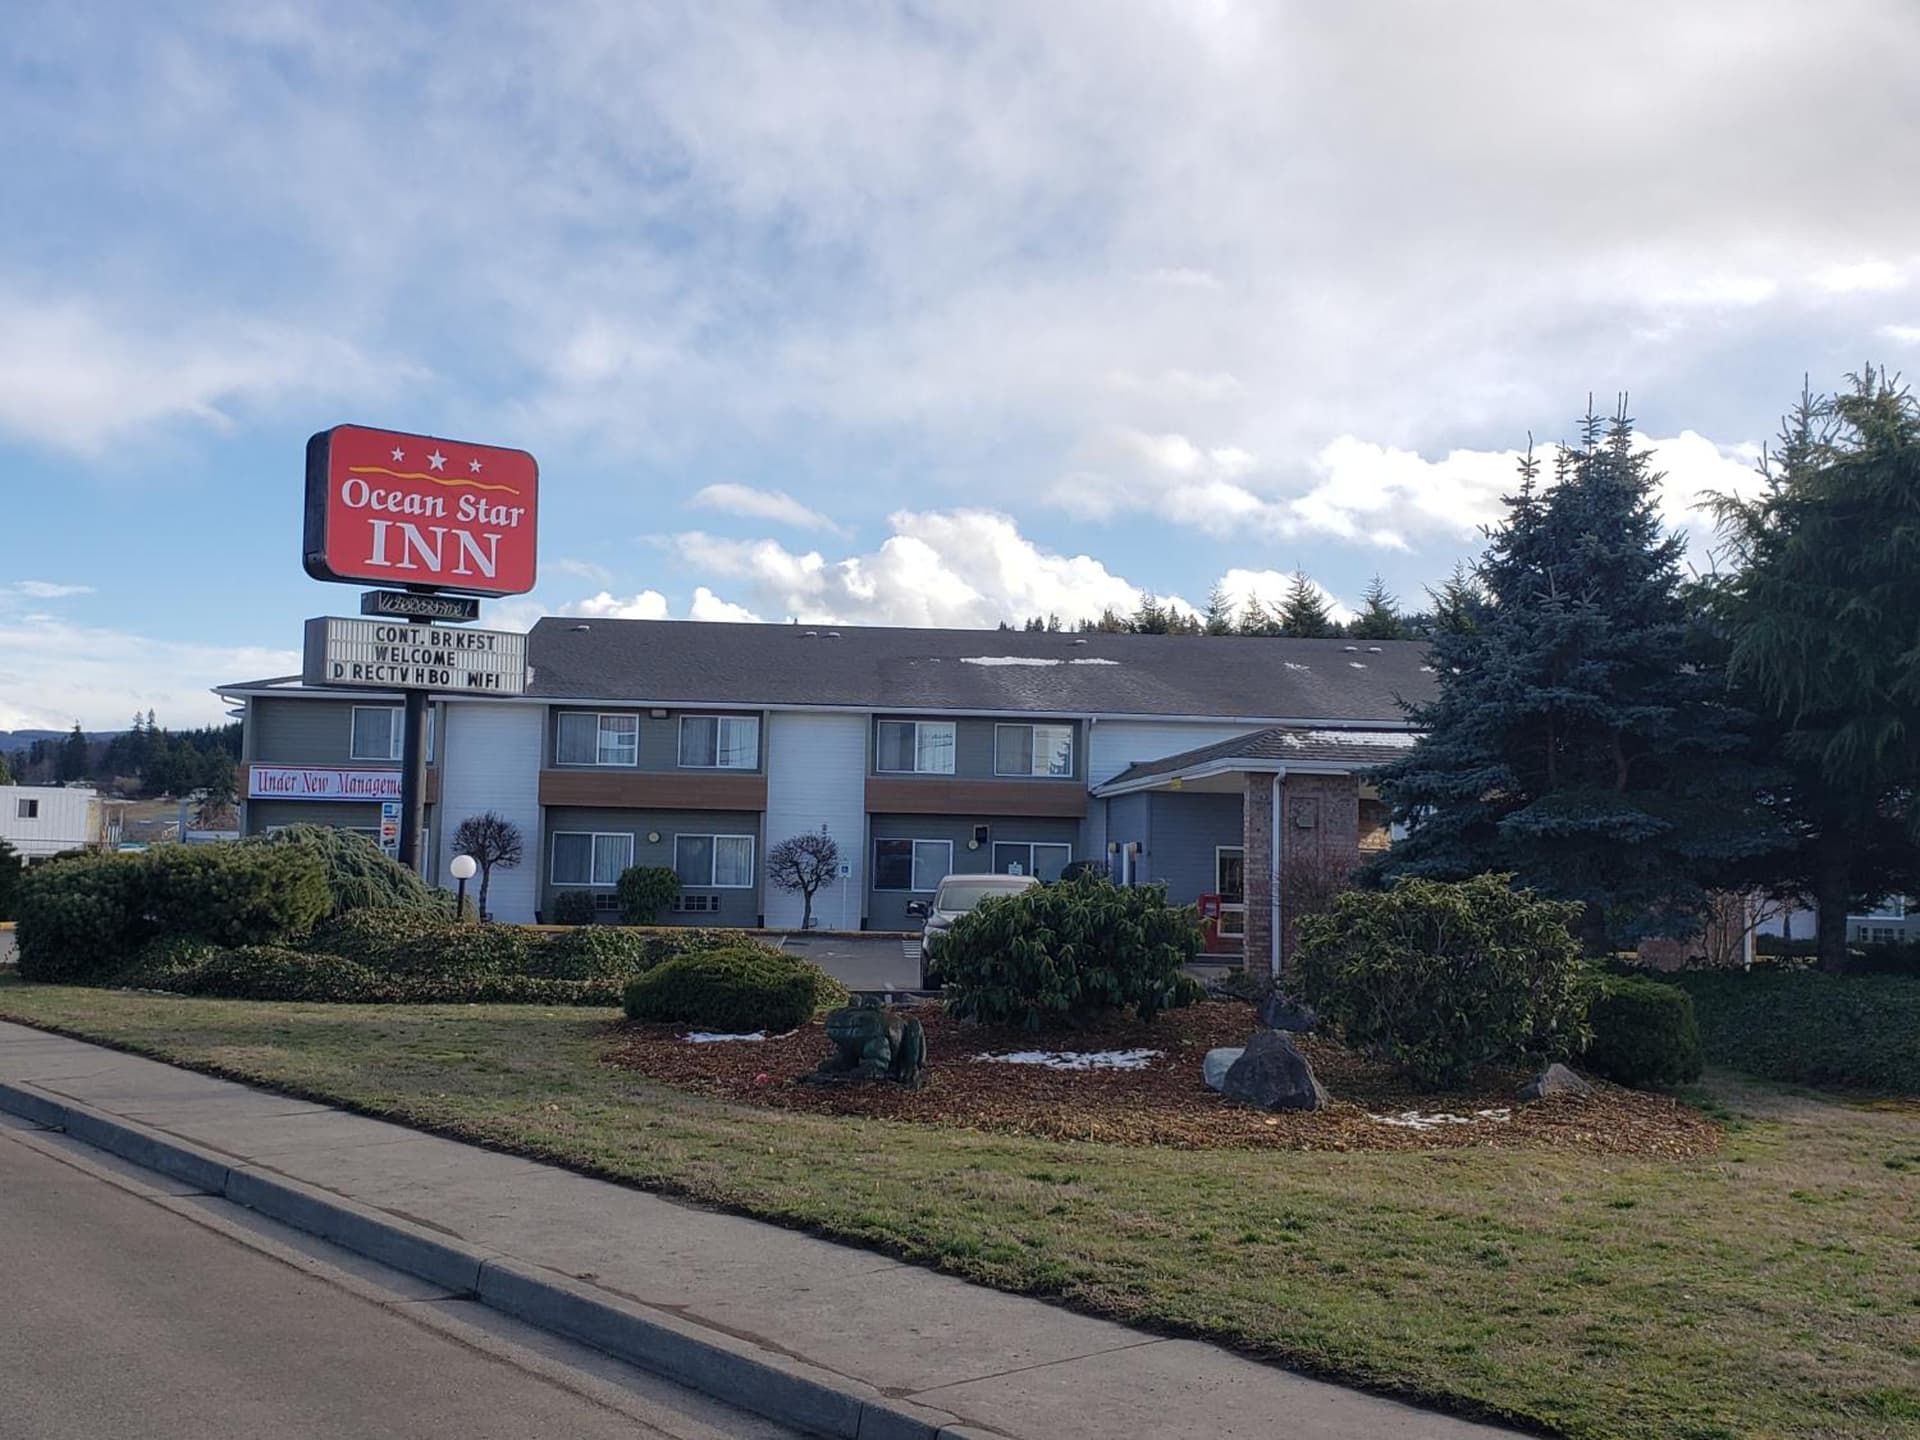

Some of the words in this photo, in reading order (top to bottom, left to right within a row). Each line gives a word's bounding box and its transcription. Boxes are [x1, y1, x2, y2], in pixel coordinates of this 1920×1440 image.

[341, 478, 447, 518] Ocean
[456, 494, 525, 528] Star
[364, 518, 503, 578] INN
[375, 626, 425, 645] CONT.
[431, 631, 495, 651] BRKFST
[374, 645, 455, 667] WELCOME
[415, 667, 450, 685] HBO
[467, 672, 500, 689] WIFI
[258, 771, 297, 793] Under
[302, 772, 328, 793] New
[337, 773, 402, 797] Manageme
